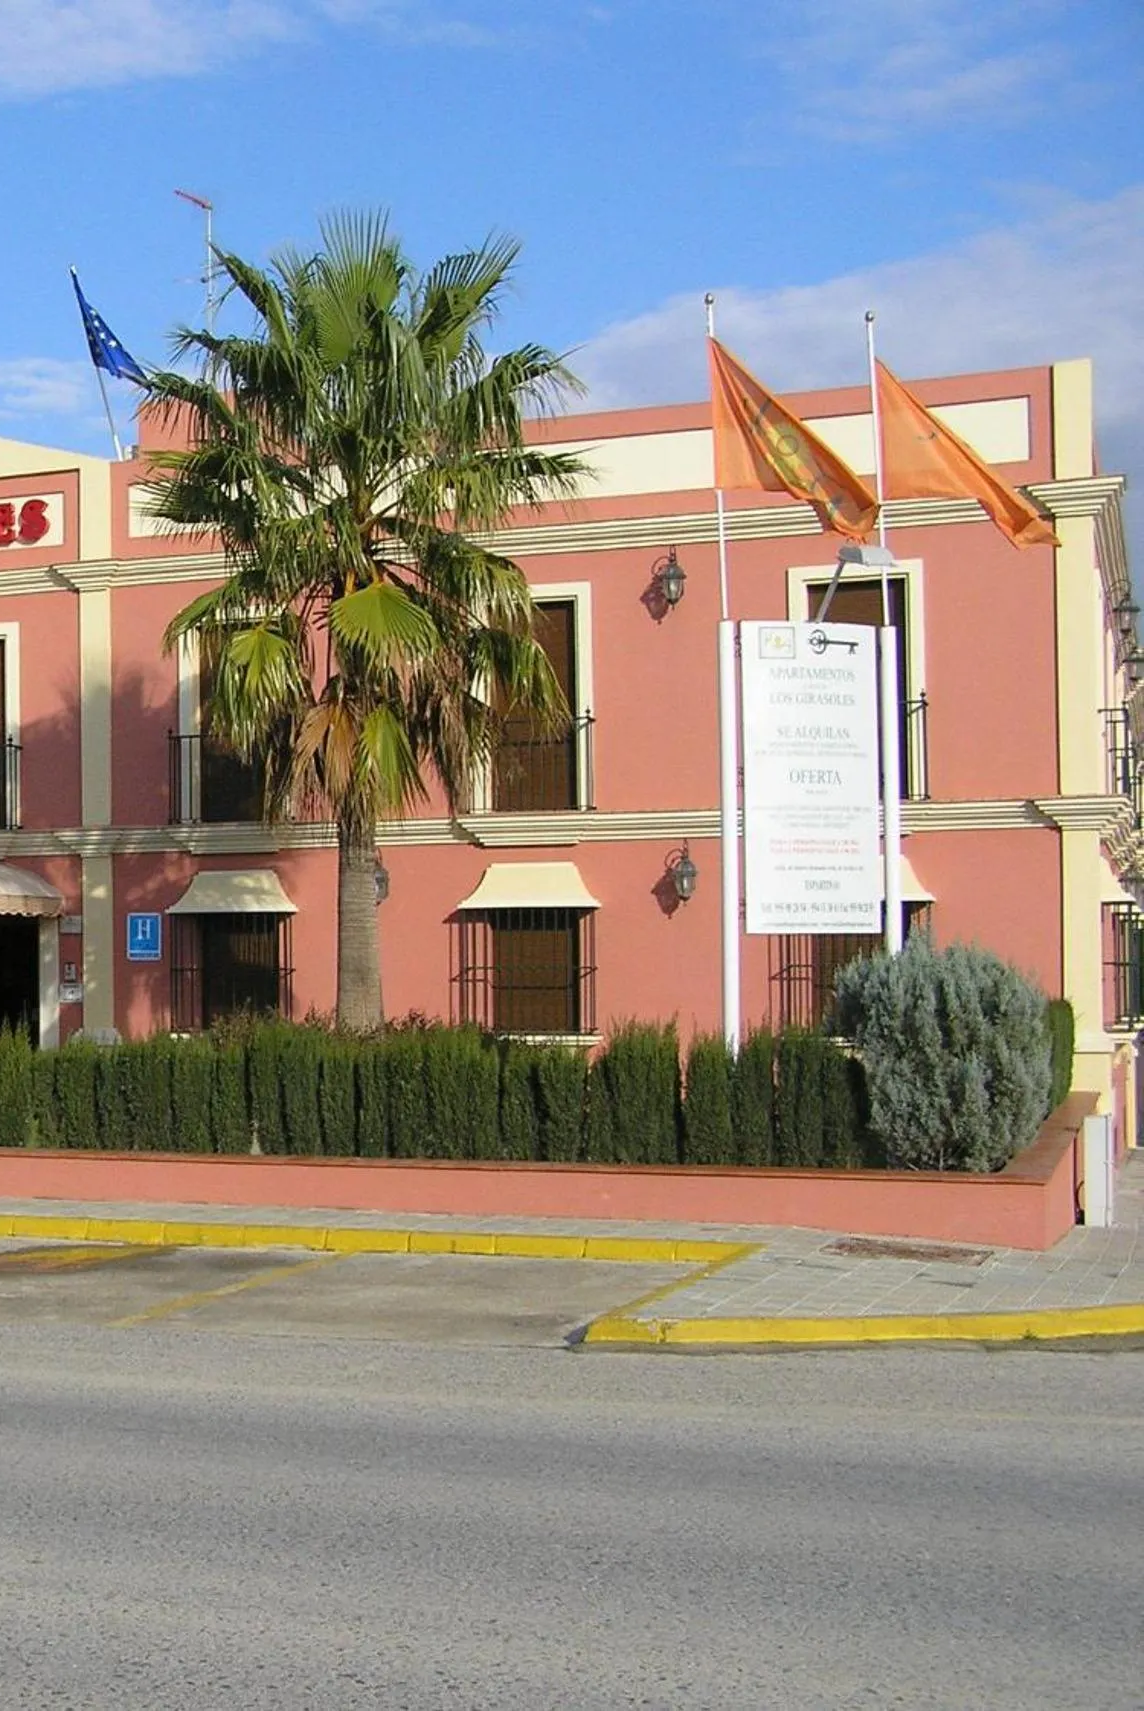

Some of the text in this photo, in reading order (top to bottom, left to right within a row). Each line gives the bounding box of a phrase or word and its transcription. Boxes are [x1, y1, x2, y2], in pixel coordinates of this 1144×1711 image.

[770, 692, 856, 706] LOS GIRASOLES
[789, 769, 842, 786] OFERTA
